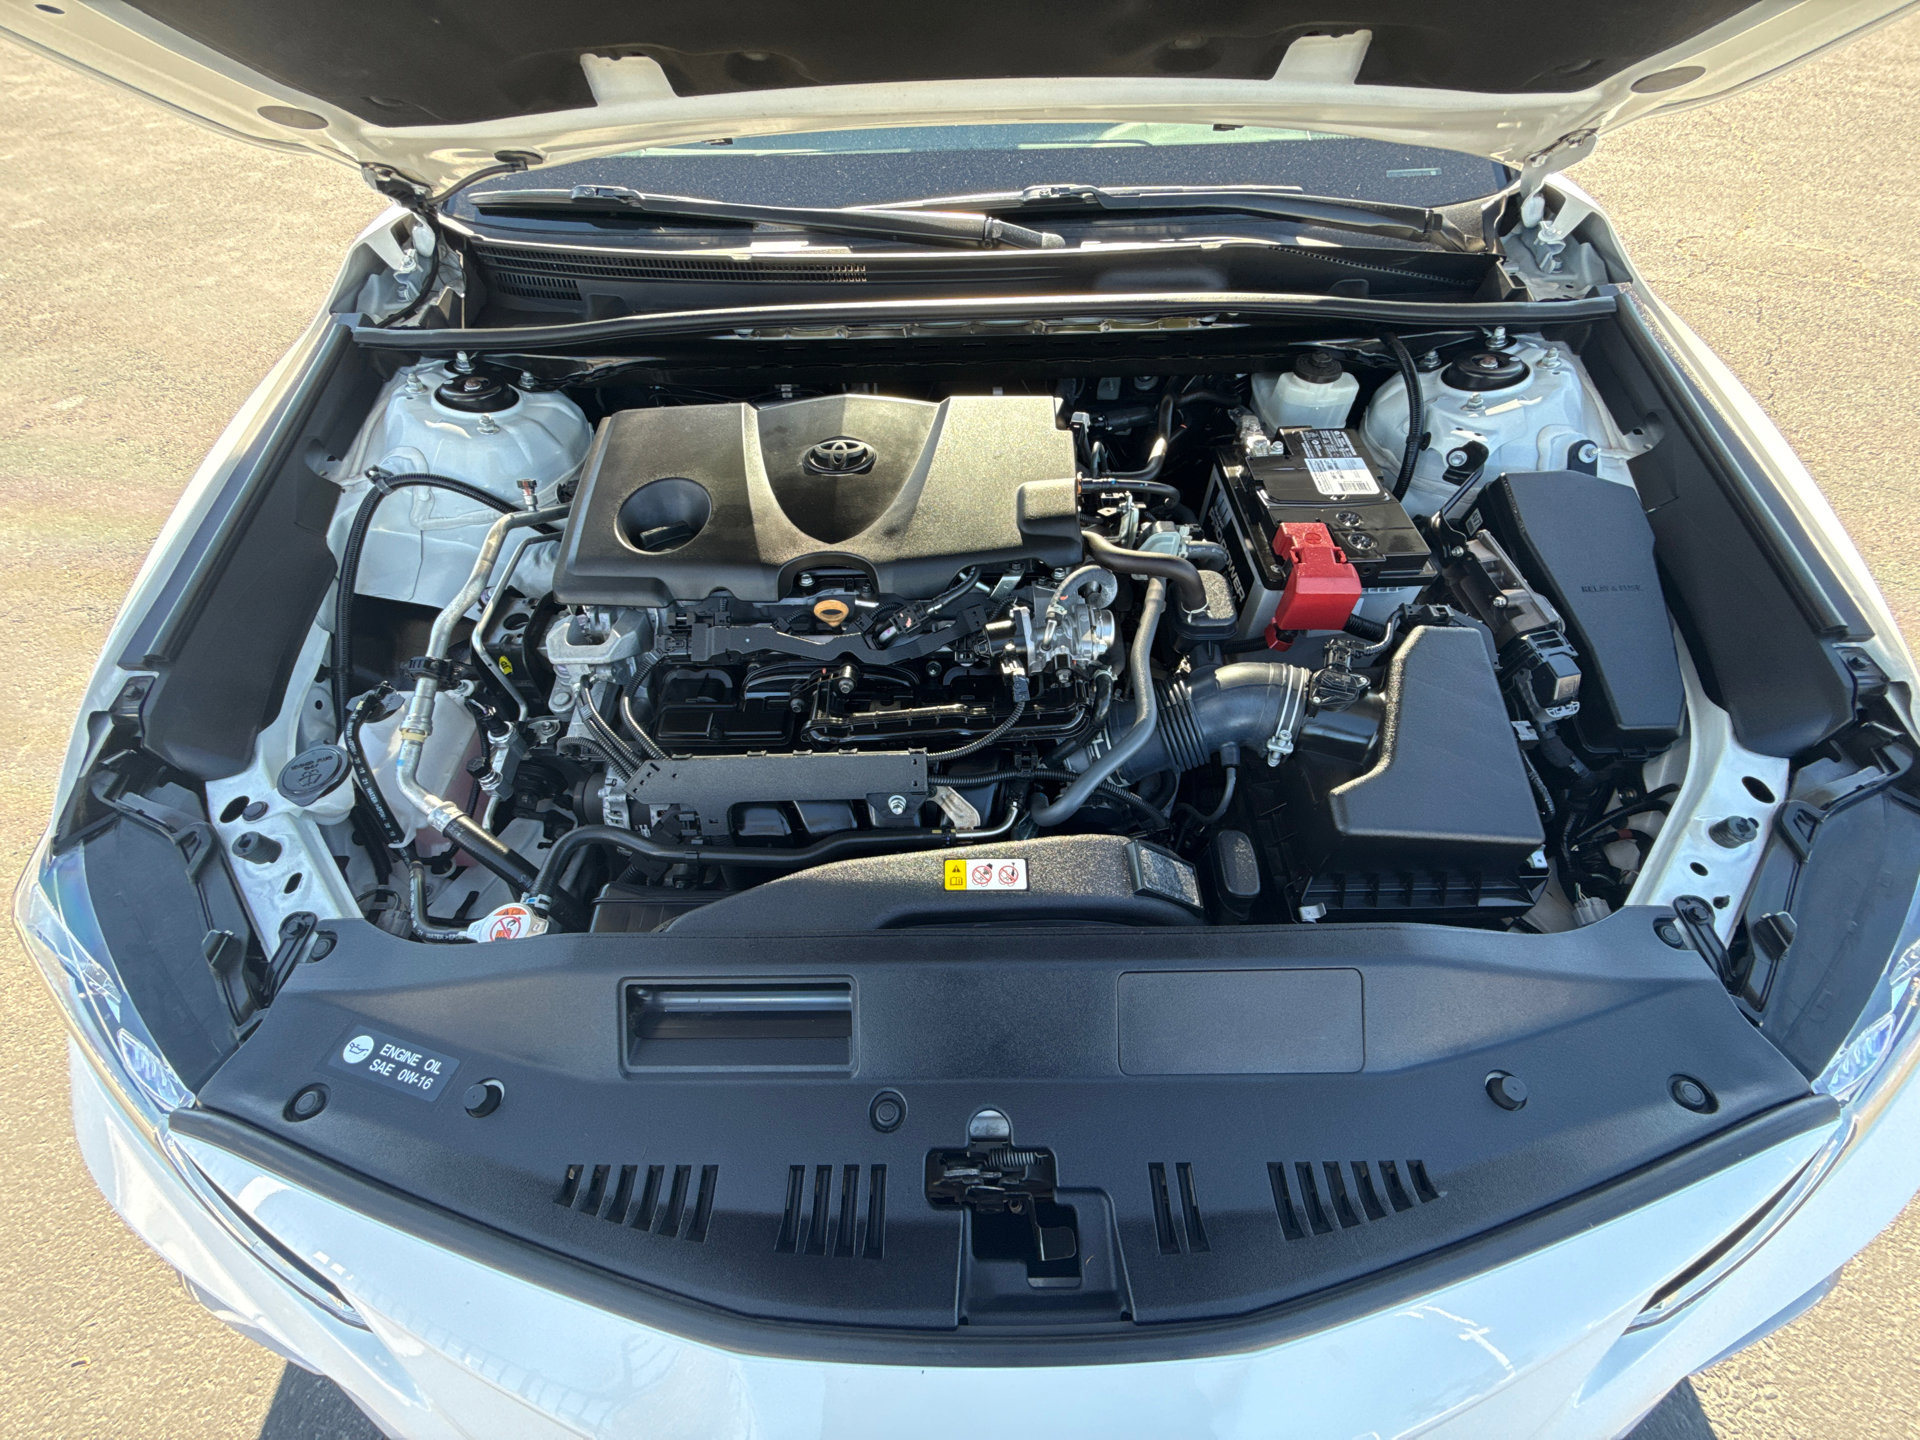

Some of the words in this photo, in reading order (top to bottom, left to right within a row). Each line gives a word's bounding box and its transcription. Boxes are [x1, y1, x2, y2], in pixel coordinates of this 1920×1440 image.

[1581, 583, 1609, 593] RELAY
[1619, 584, 1643, 592] FUSE
[368, 1058, 396, 1077] SAE
[397, 1068, 434, 1091] 0W-16
[379, 1043, 423, 1067] ENGINE
[423, 1058, 443, 1075] OIL
